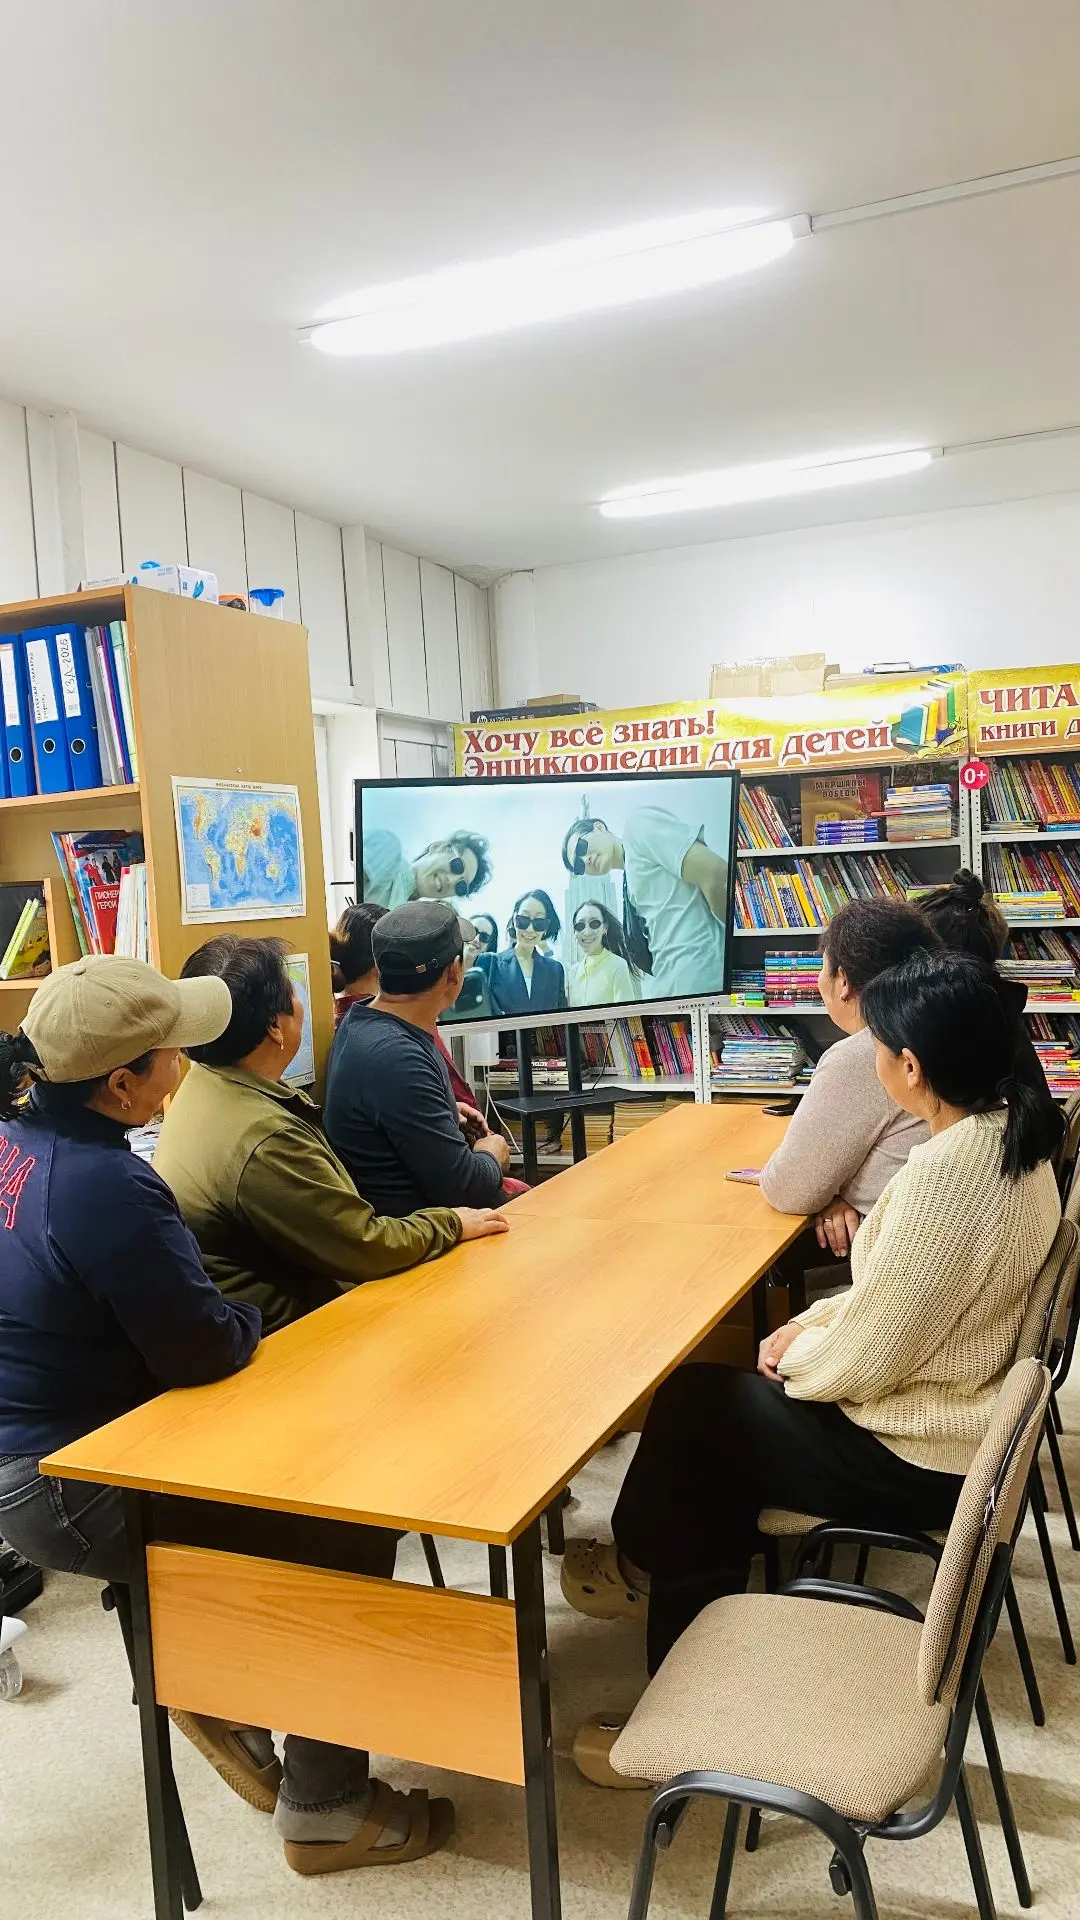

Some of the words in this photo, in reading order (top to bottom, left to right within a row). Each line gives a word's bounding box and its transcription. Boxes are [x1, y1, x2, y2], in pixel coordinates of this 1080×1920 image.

[979, 684, 1080, 713] ЧИТА
[463, 730, 540, 757] Хочу
[550, 720, 604, 747] всё
[613, 709, 715, 744] знать!
[979, 720, 1057, 741] книги
[464, 744, 699, 777] Энциклопедии
[708, 737, 771, 765] для
[782, 720, 890, 759] детей
[814, 778, 866, 790] МАРШАЛЫ
[963, 767, 987, 785] 0+
[821, 789, 860, 799] ПОБЕДЫ
